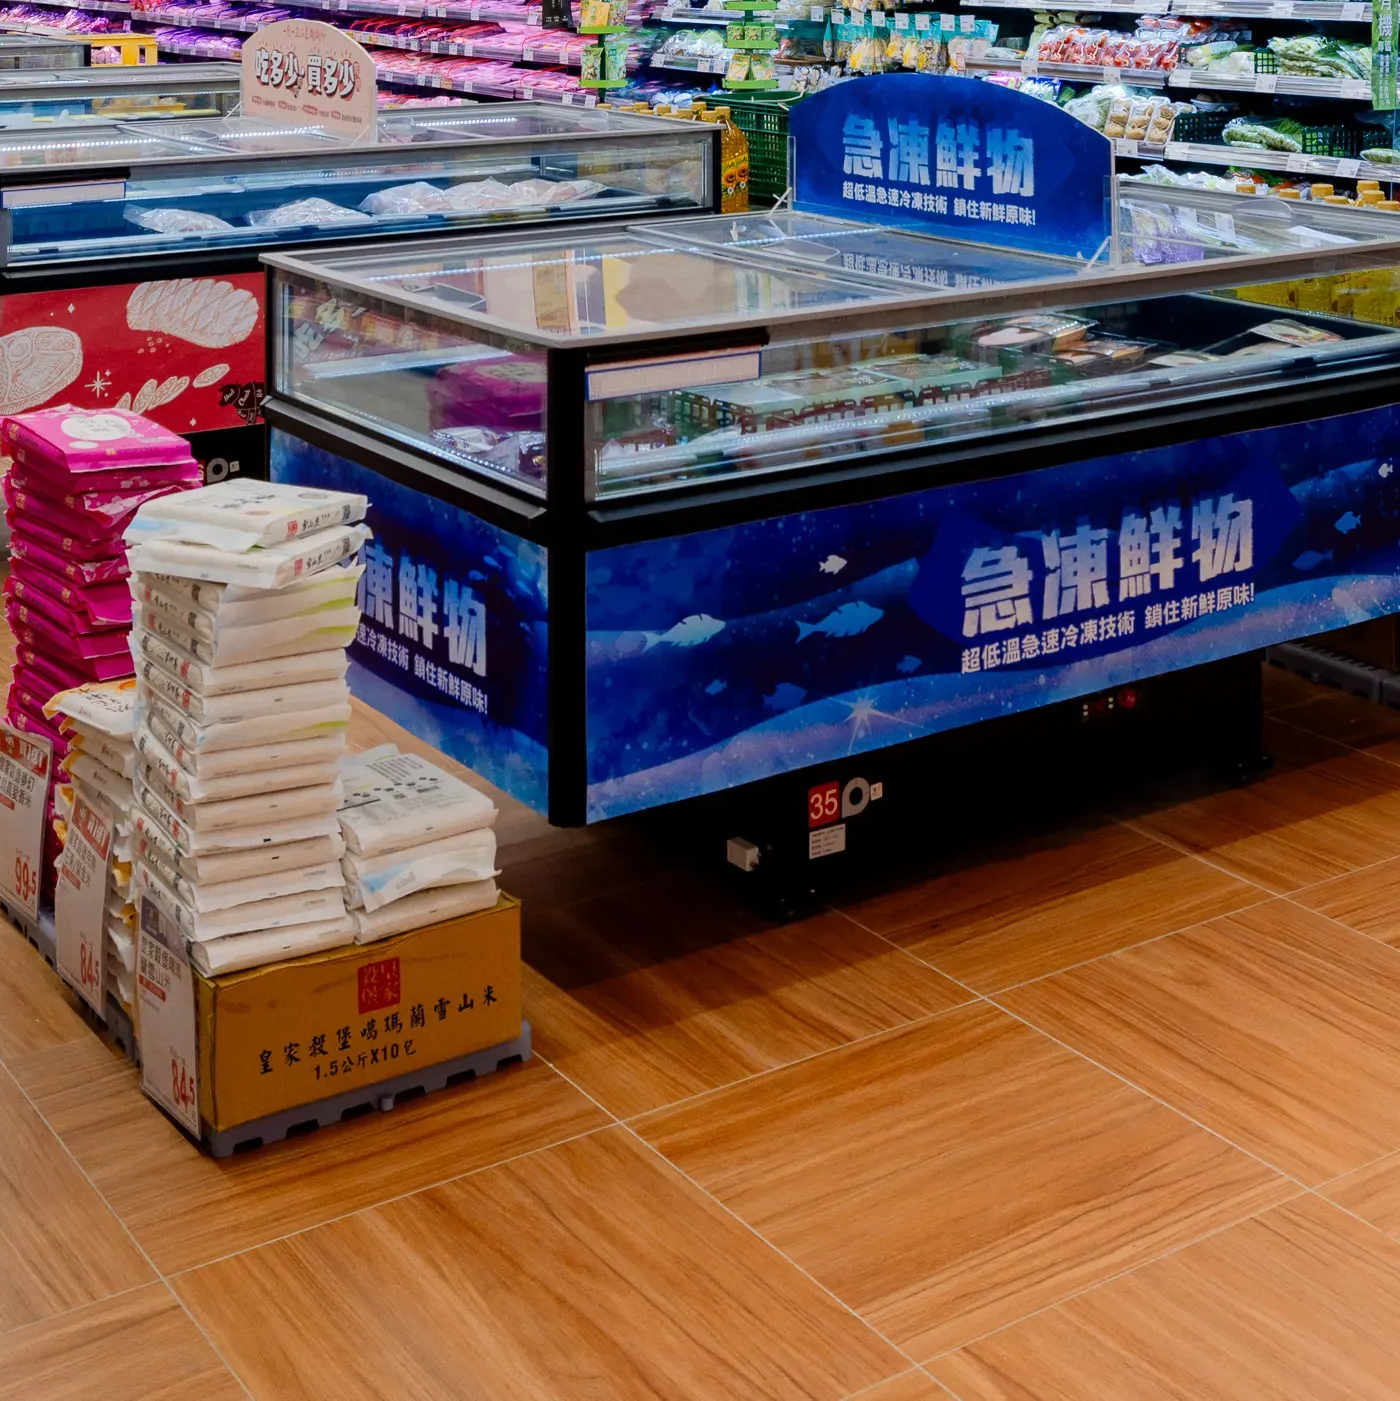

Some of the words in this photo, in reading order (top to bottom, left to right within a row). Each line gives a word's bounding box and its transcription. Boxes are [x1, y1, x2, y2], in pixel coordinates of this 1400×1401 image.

[254, 47, 305, 90] 吃多少
[307, 54, 355, 100] 買多少
[843, 113, 1035, 198] 急凍鮮物
[842, 181, 948, 215] 超低溫急速冷凍技術
[953, 197, 1036, 227] 鎖住新鮮原味!
[961, 493, 1254, 638] 急凍鮮物
[356, 543, 487, 677] 凍鮮物
[961, 610, 1136, 675] 超低溫急速冷凍技術
[1143, 583, 1256, 630] 鎖住新鮮原味!
[357, 625, 409, 671] 速冷凍技術
[413, 654, 488, 714] 鎖住新鮮原味!
[810, 788, 838, 820] 35
[14, 861, 37, 902] 99.5
[79, 946, 100, 988] 84.5
[258, 984, 498, 1075] 皇家穀堡噶瑪蘭雪山米
[171, 1058, 197, 1113] 84.5
[313, 1038, 417, 1080] 1.5公斤X10包
